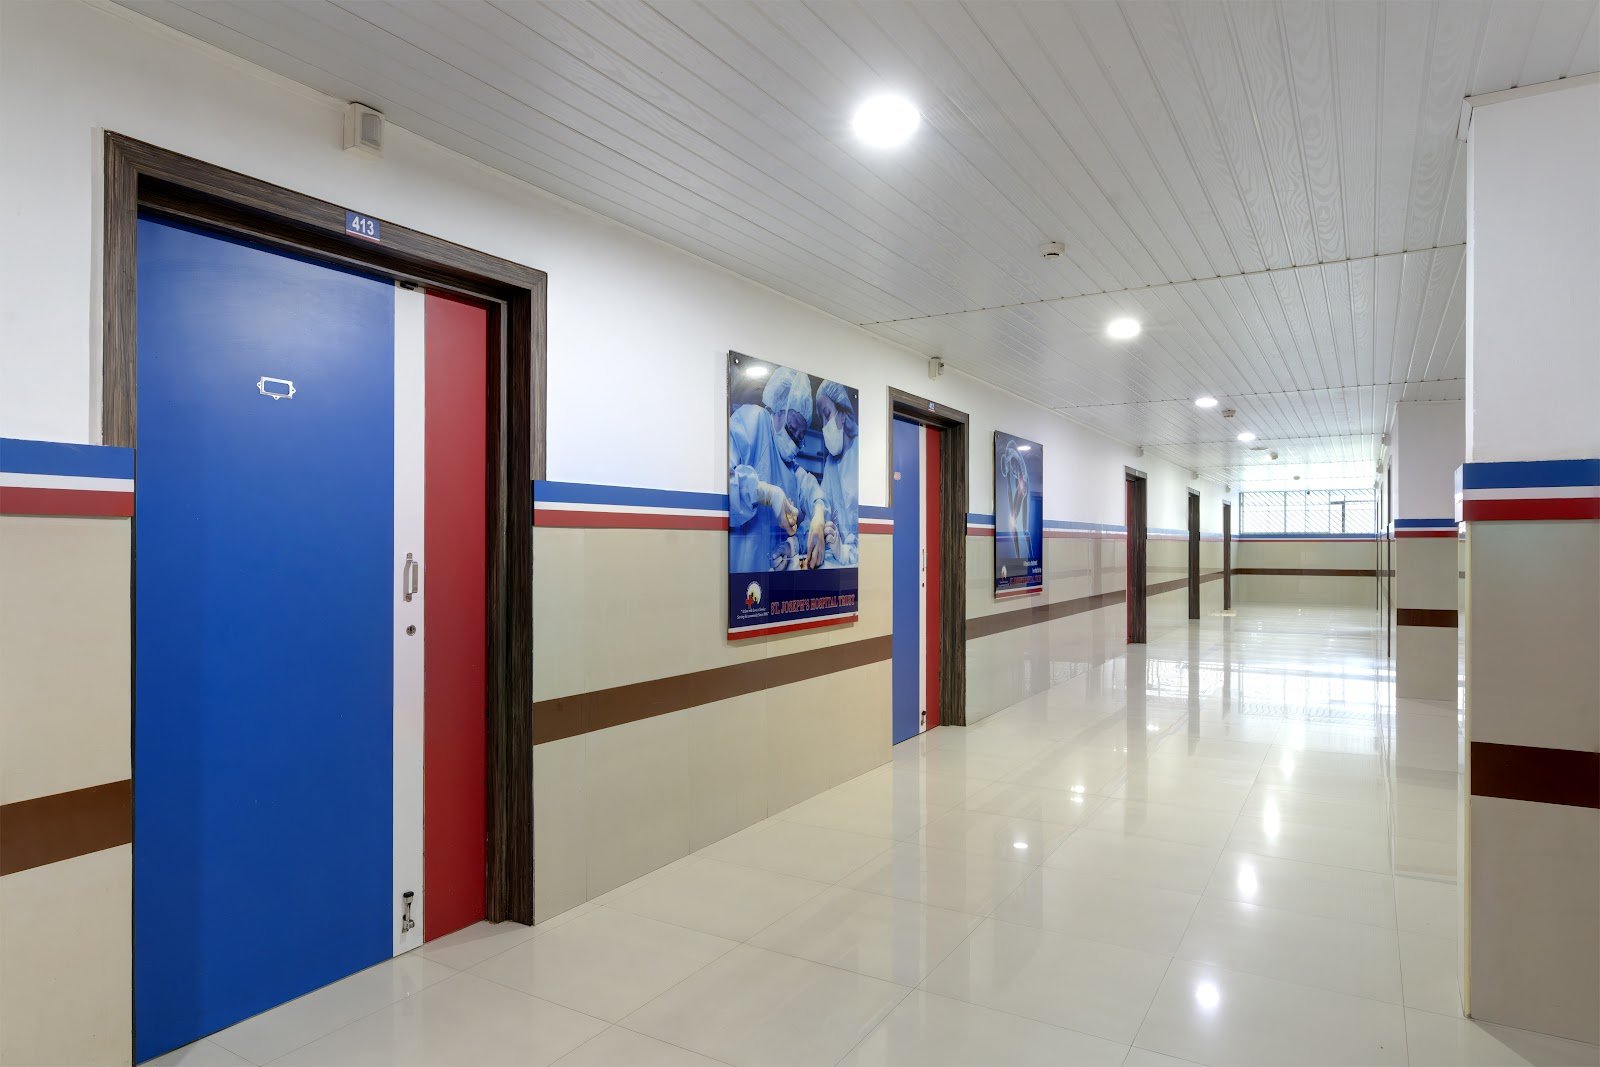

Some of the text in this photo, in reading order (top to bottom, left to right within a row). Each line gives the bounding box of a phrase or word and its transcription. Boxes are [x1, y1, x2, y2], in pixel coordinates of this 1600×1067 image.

[352, 216, 374, 235] 413
[770, 602, 780, 615] ST.
[781, 598, 810, 614] JOSEPH'S
[810, 596, 838, 610] HOSPITAL
[838, 594, 855, 606] TRUST
